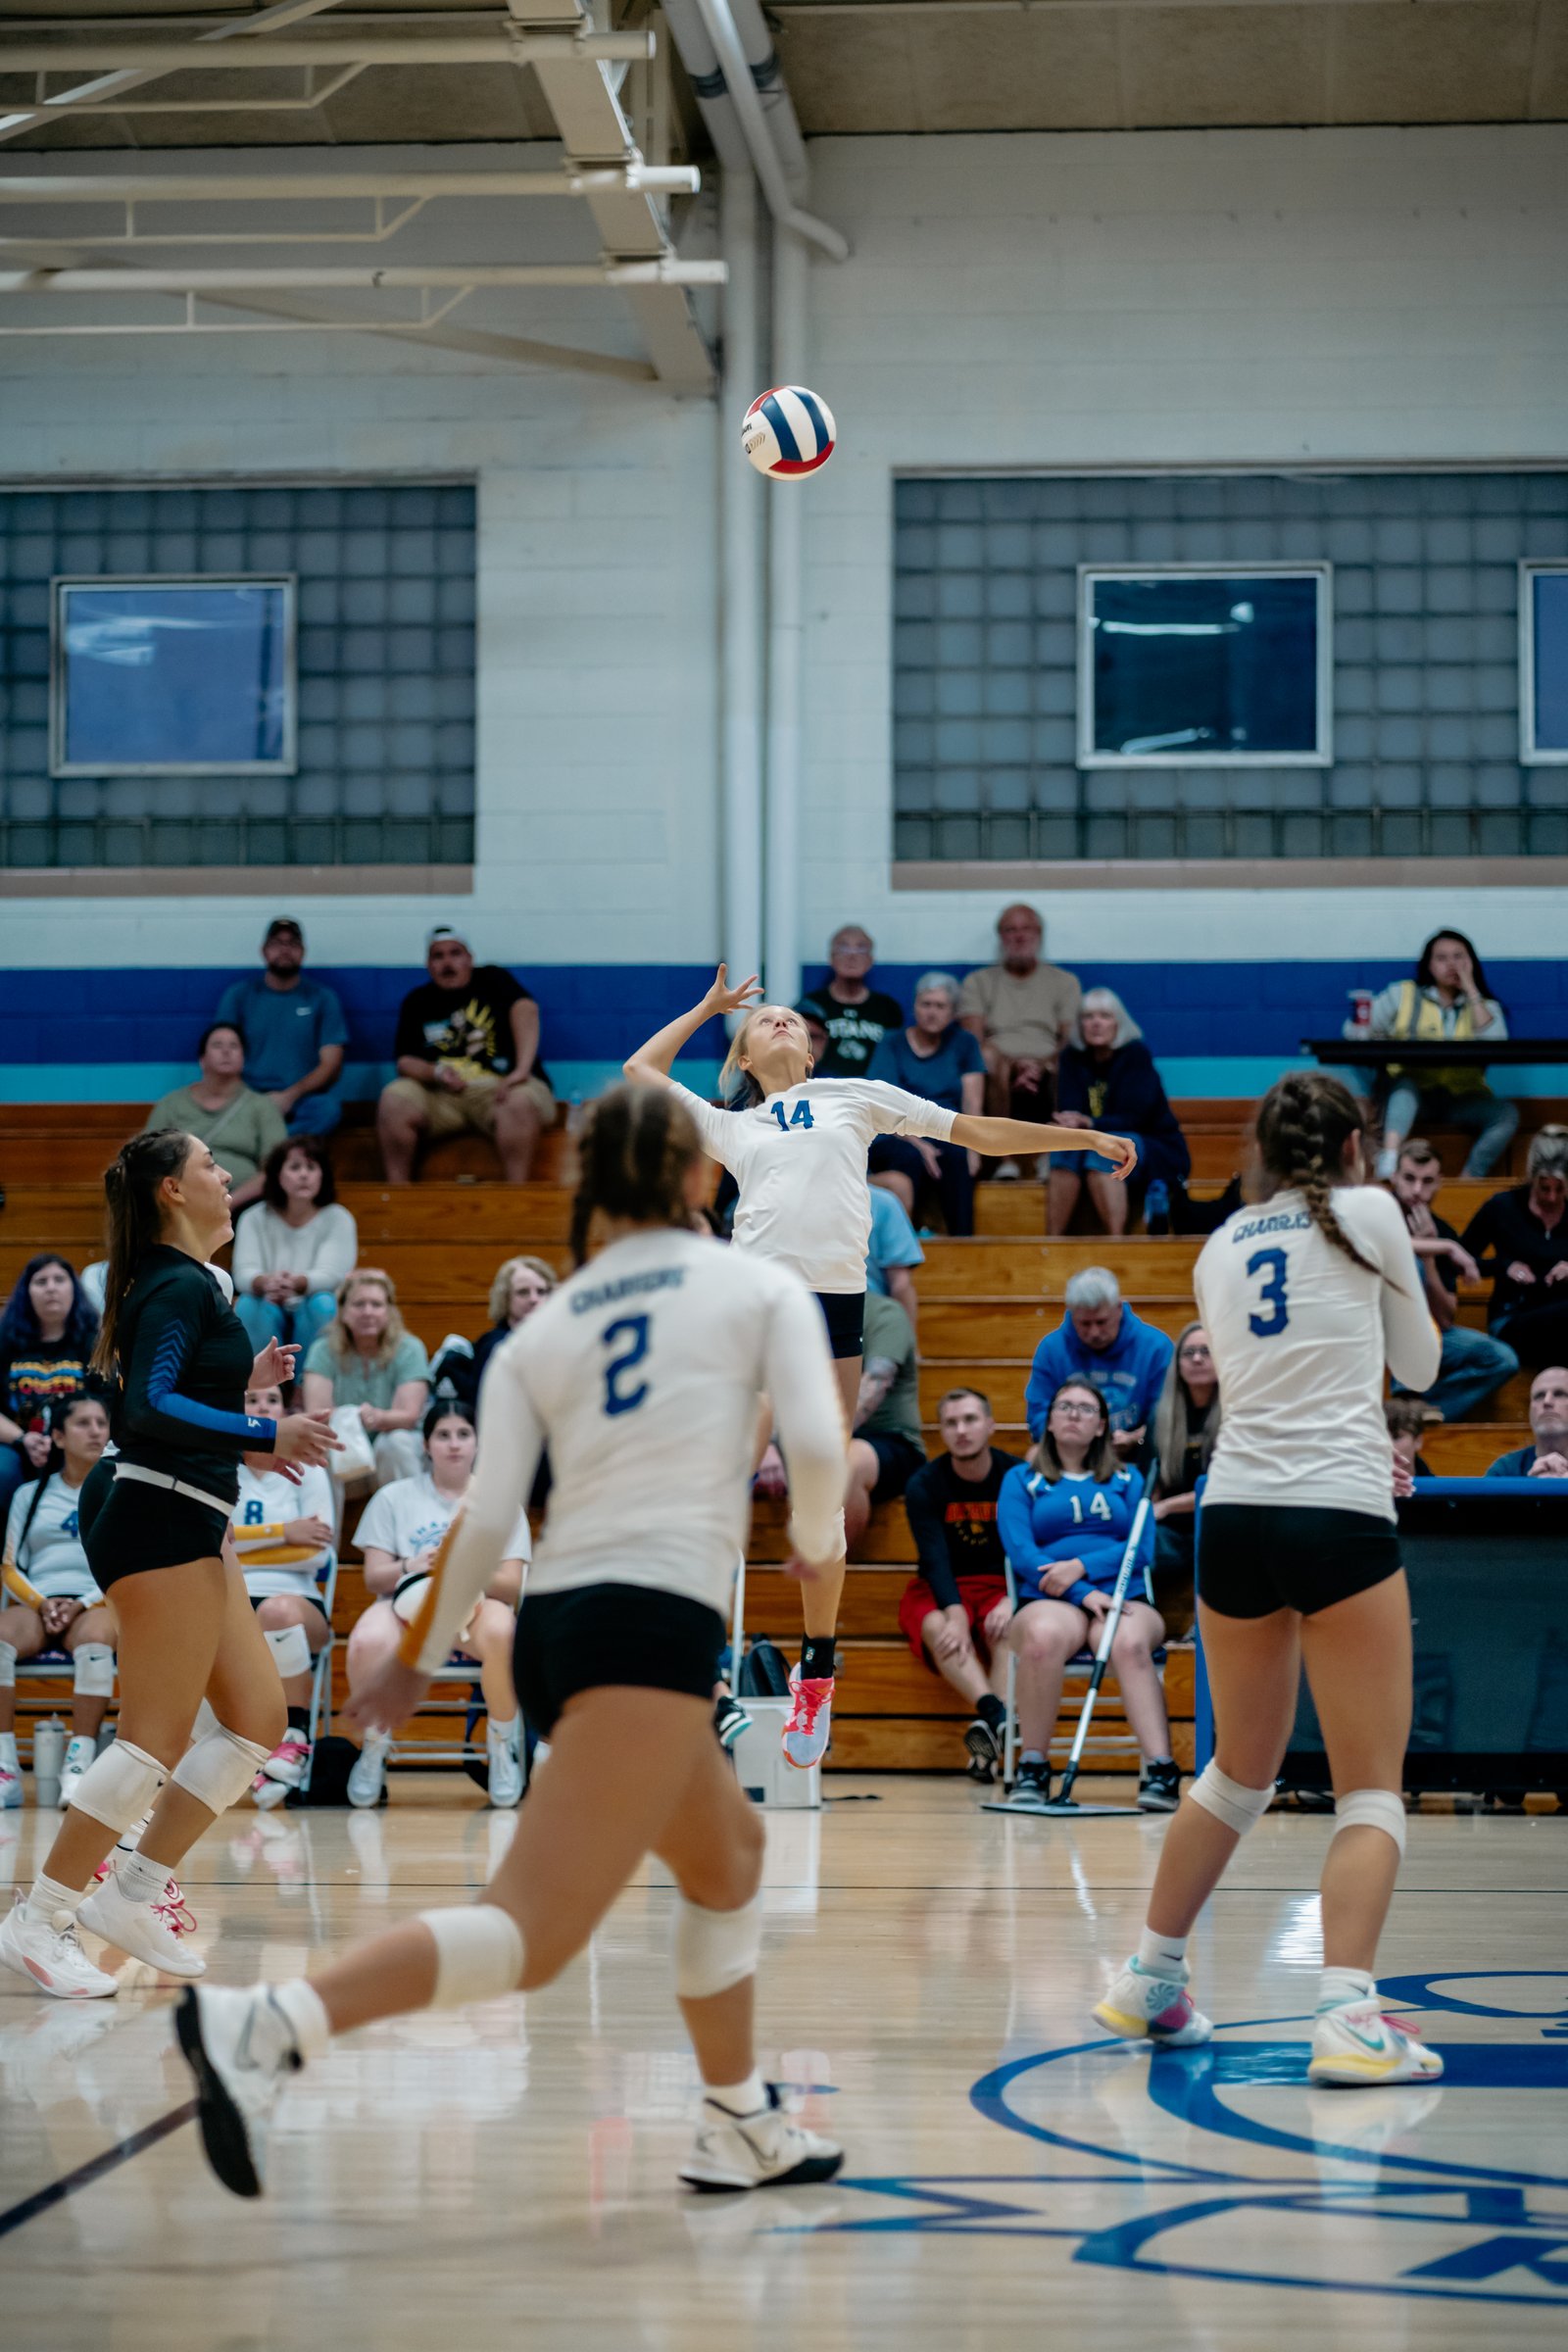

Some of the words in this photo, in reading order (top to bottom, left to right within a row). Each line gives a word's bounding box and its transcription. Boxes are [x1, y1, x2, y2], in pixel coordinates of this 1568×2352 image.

[770, 1100, 814, 1132] 14
[1246, 1247, 1289, 1339] 3
[603, 1313, 651, 1415] 2
[245, 1500, 264, 1525] 8
[1069, 1492, 1111, 1523] 14
[61, 1510, 78, 1538] 4
